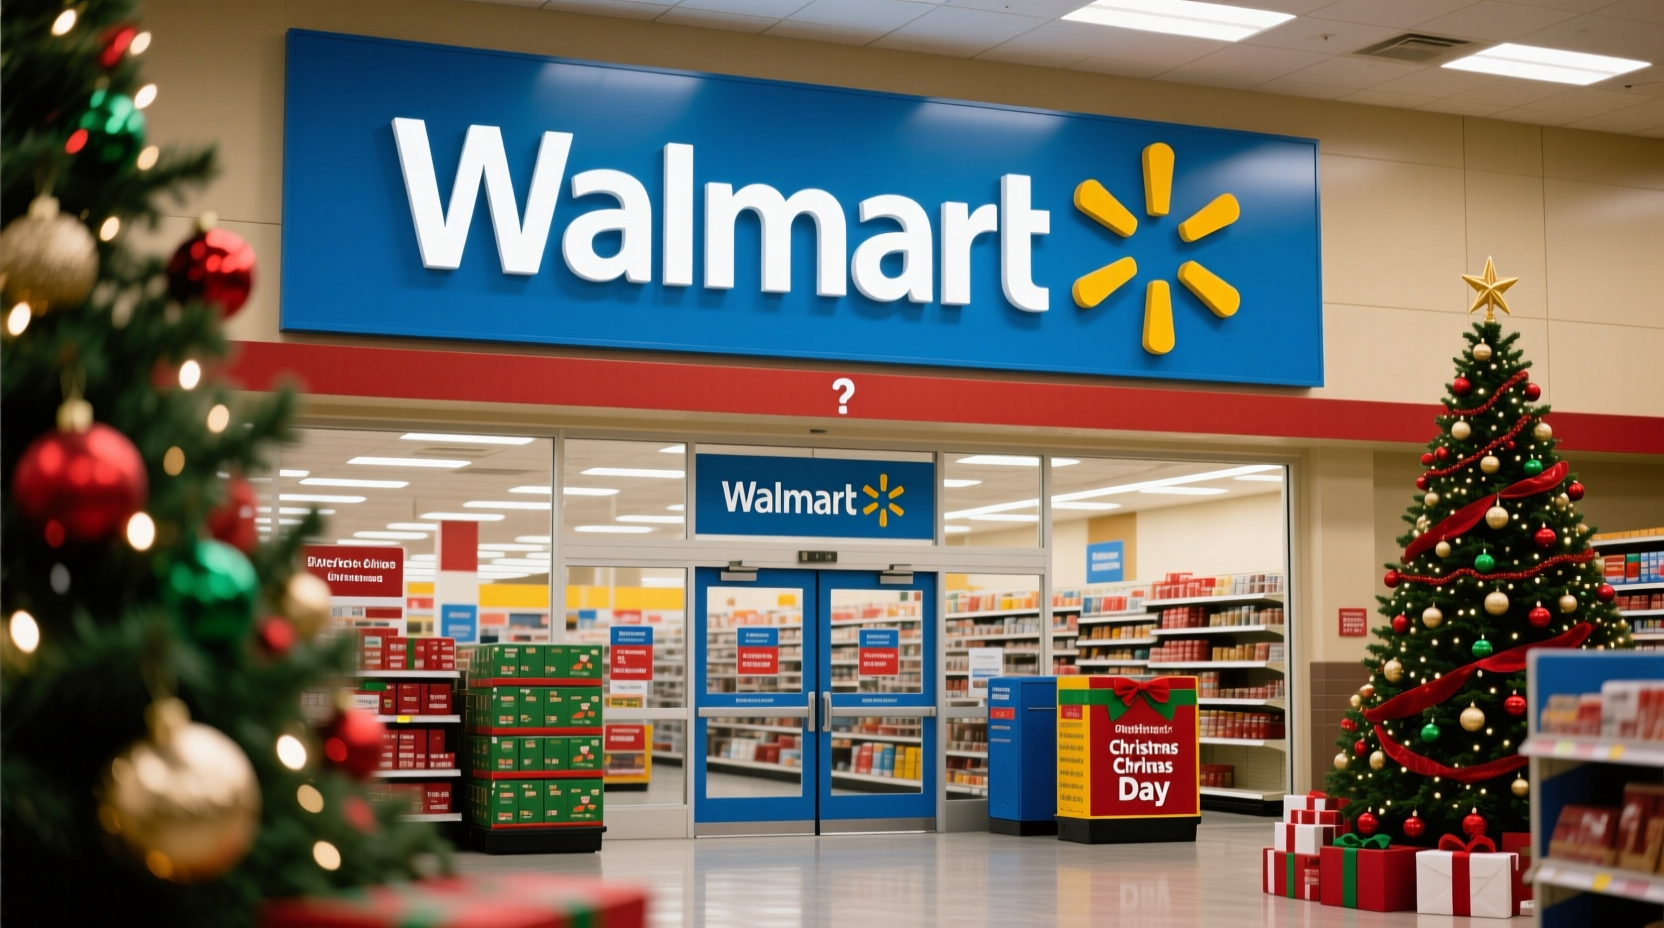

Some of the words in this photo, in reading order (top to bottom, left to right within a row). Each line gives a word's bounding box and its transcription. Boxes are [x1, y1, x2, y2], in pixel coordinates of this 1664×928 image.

[391, 117, 1050, 312] Walmart
[832, 377, 854, 415] ?
[721, 480, 858, 515] Walmart
[1119, 776, 1171, 807] Day
